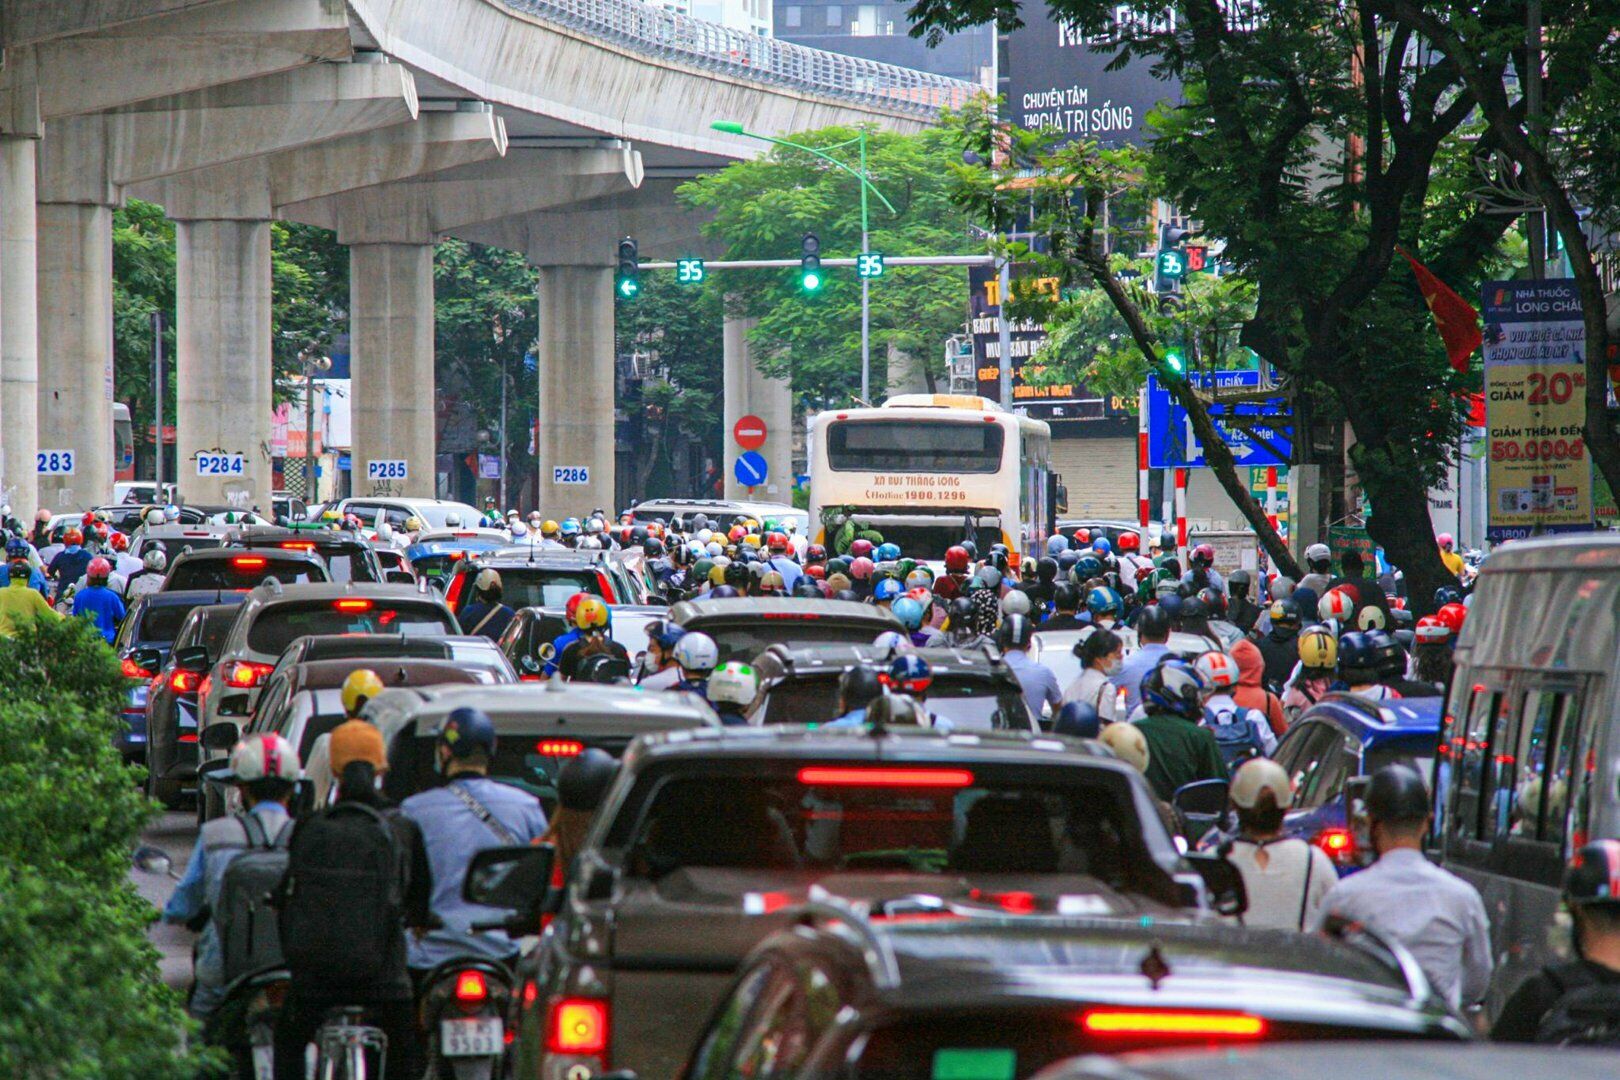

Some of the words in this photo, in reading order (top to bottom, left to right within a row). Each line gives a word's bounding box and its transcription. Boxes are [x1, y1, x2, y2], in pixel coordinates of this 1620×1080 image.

[1023, 87, 1065, 109] CHUYÊN
[1066, 84, 1088, 105] TÂM
[1024, 113, 1040, 129] TẠO
[1091, 99, 1133, 131] SỐNG
[679, 261, 702, 281] 35
[860, 255, 882, 276] 35
[1537, 287, 1571, 297] THUỐC
[1516, 302, 1550, 313] LONG
[985, 342, 1009, 358] MU
[1490, 388, 1524, 401] GIẢM
[1491, 426, 1521, 438] GIẢM
[1525, 426, 1556, 437] THÊM
[199, 457, 242, 473] P284
[369, 462, 406, 478] P285
[554, 467, 588, 482] P286
[937, 476, 960, 486] LONG
